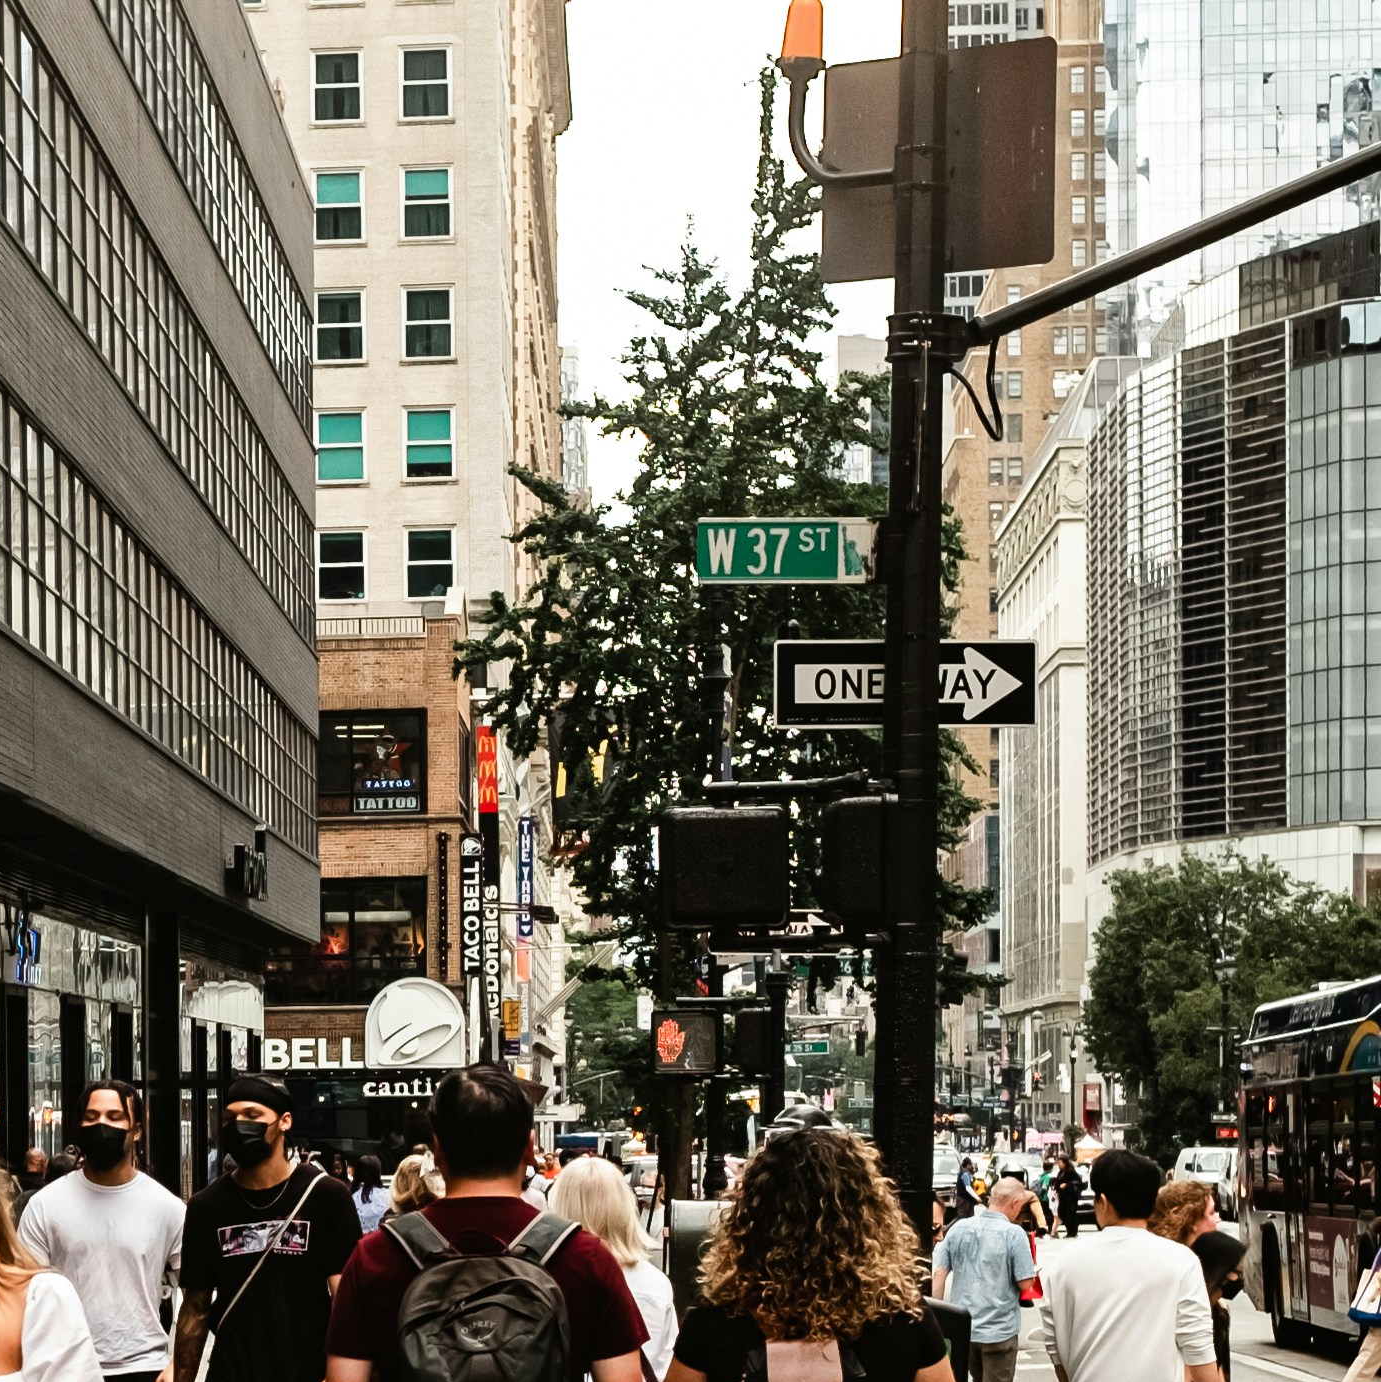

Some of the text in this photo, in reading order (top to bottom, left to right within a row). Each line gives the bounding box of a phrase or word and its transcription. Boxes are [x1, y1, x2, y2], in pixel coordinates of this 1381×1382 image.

[707, 527, 831, 576] W 37 ST
[814, 668, 885, 700] ONE
[365, 780, 411, 788] TATTOO
[357, 797, 417, 810] TATTOO
[463, 861, 481, 971] TACO BELL
[263, 1037, 364, 1070] BELL
